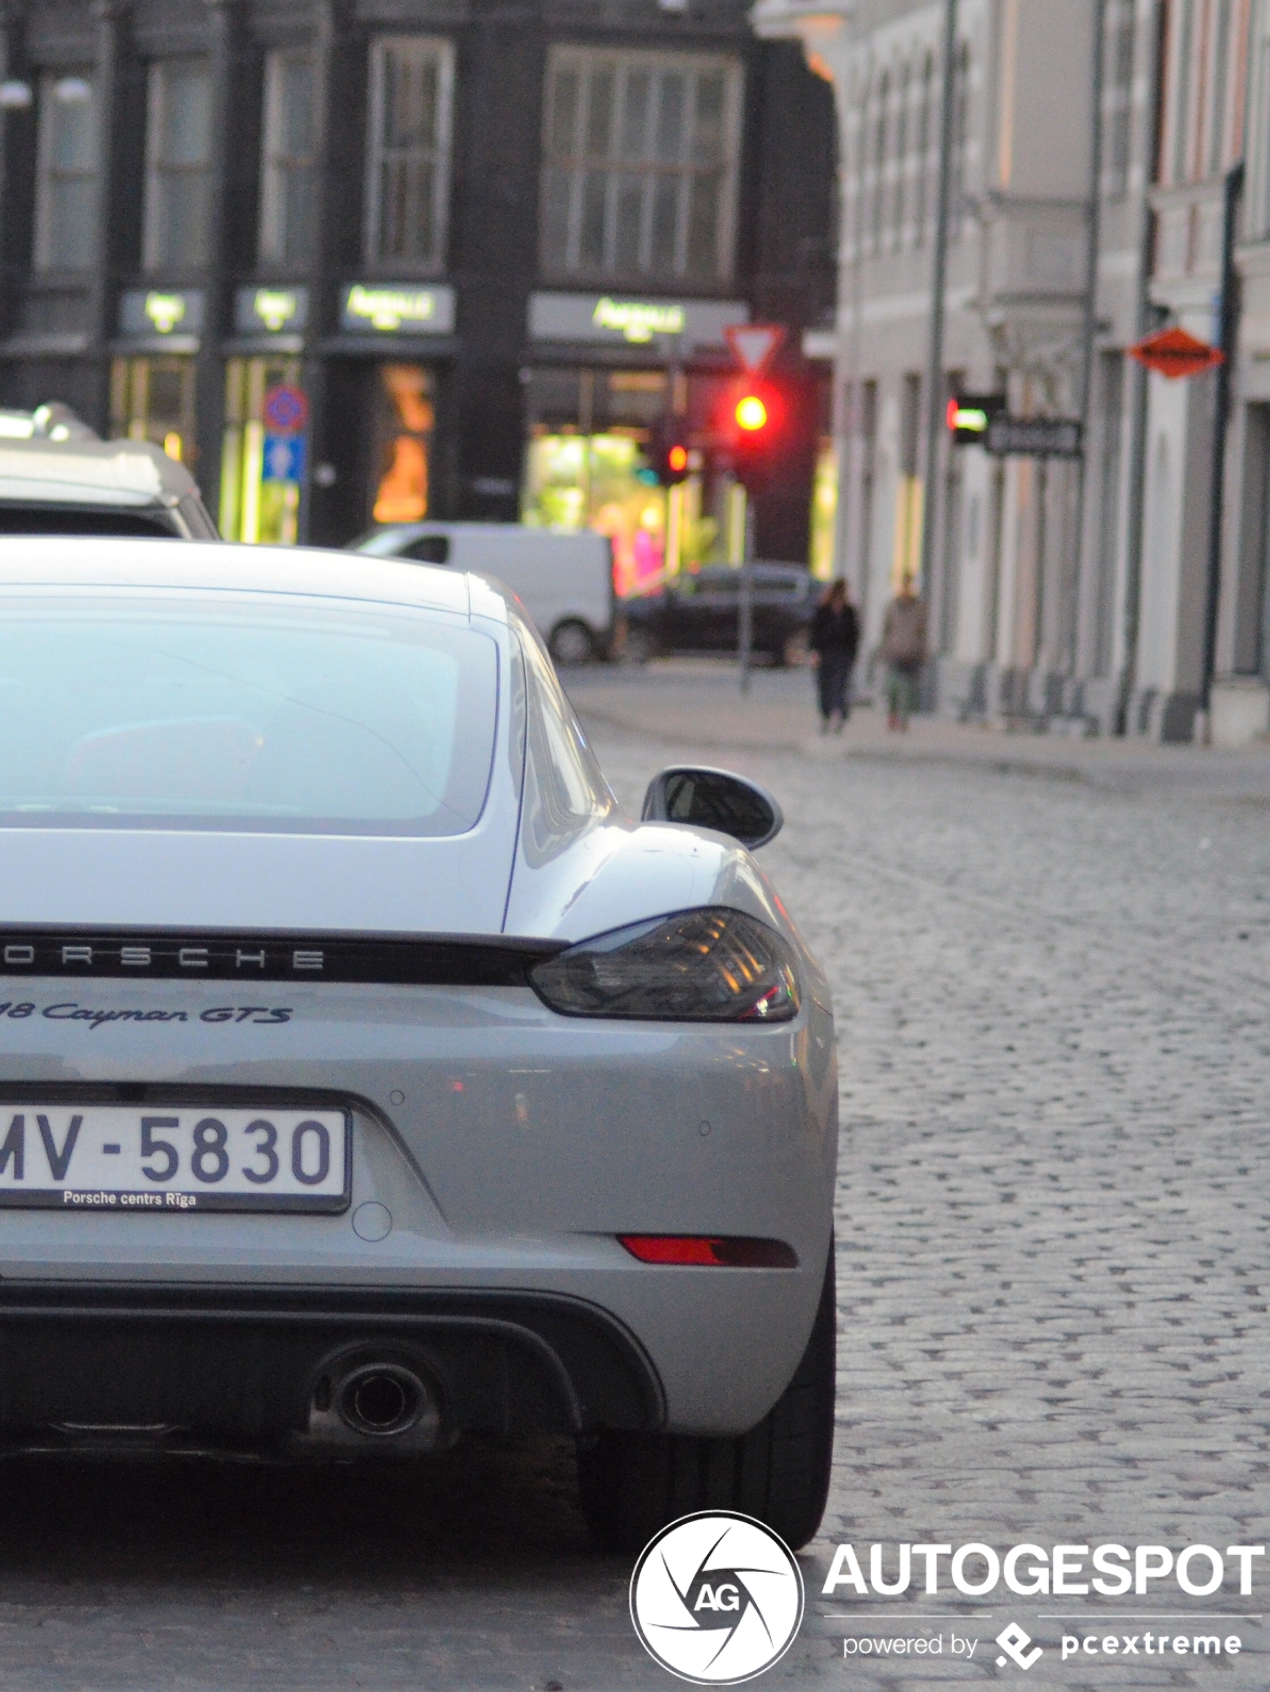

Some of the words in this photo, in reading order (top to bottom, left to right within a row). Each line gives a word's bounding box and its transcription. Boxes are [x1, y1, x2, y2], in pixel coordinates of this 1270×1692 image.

[41, 1003, 189, 1030] Cayman
[199, 1007, 294, 1024] GTS
[63, 1190, 117, 1205] Porsche
[120, 1193, 162, 1206] centrs
[165, 1192, 197, 1208] Rīga
